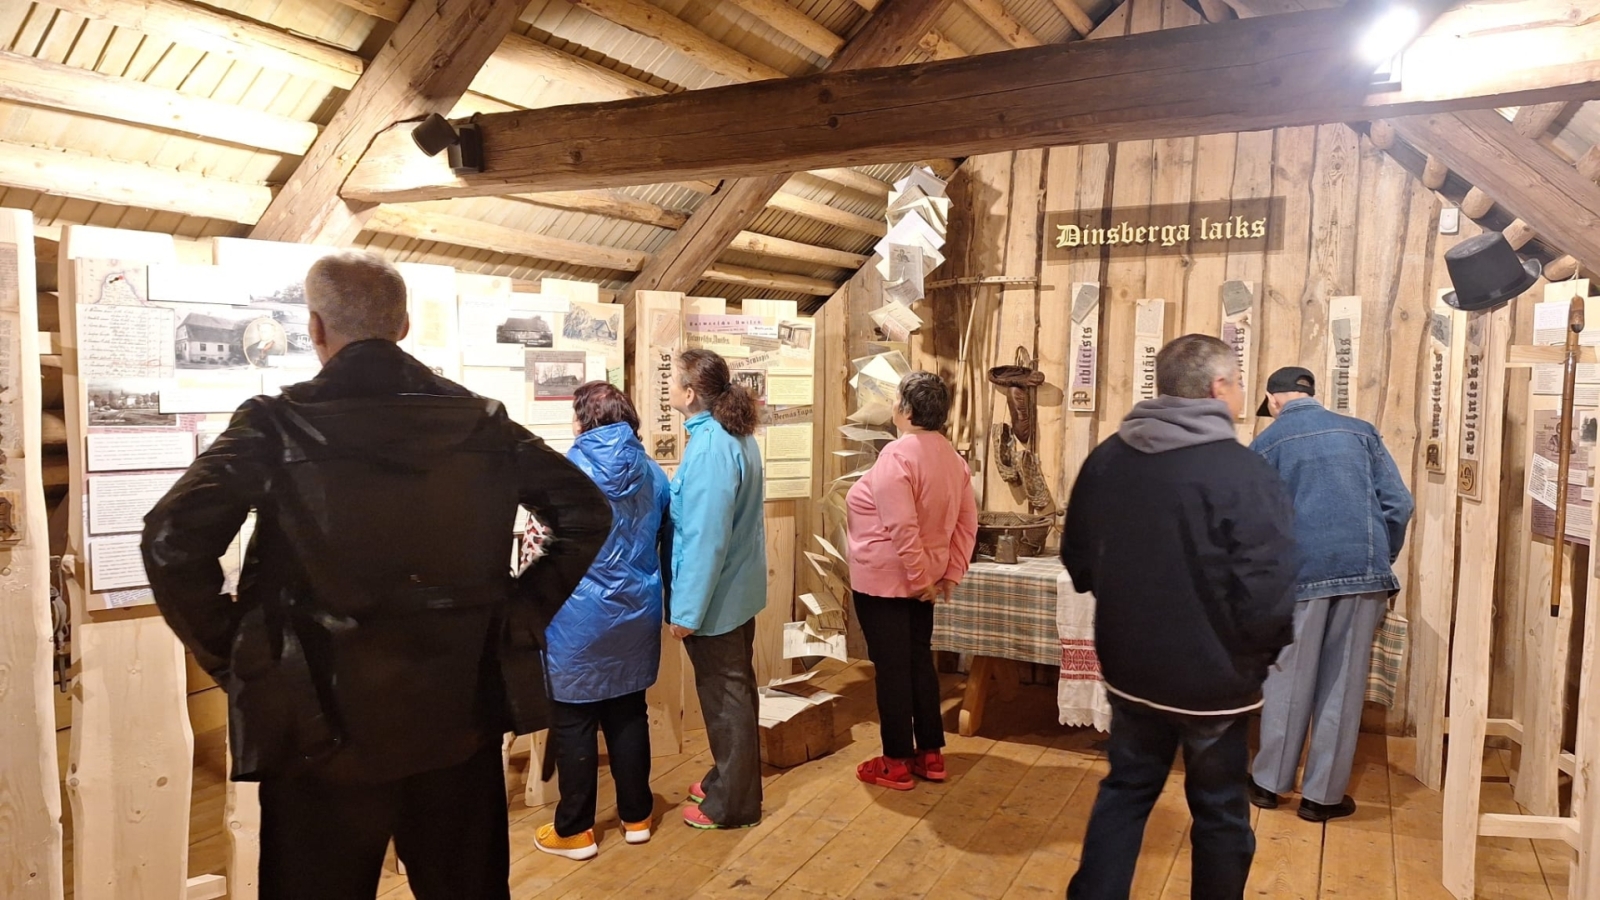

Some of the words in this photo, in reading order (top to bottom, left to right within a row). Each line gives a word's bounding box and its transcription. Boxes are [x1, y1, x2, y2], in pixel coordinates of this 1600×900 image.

[1055, 221, 1191, 248] Dinsberga
[1200, 214, 1267, 241] laiks
[1071, 326, 1093, 406] Publicists
[1335, 338, 1352, 409] matnieks
[654, 353, 677, 458] Rakstnieks
